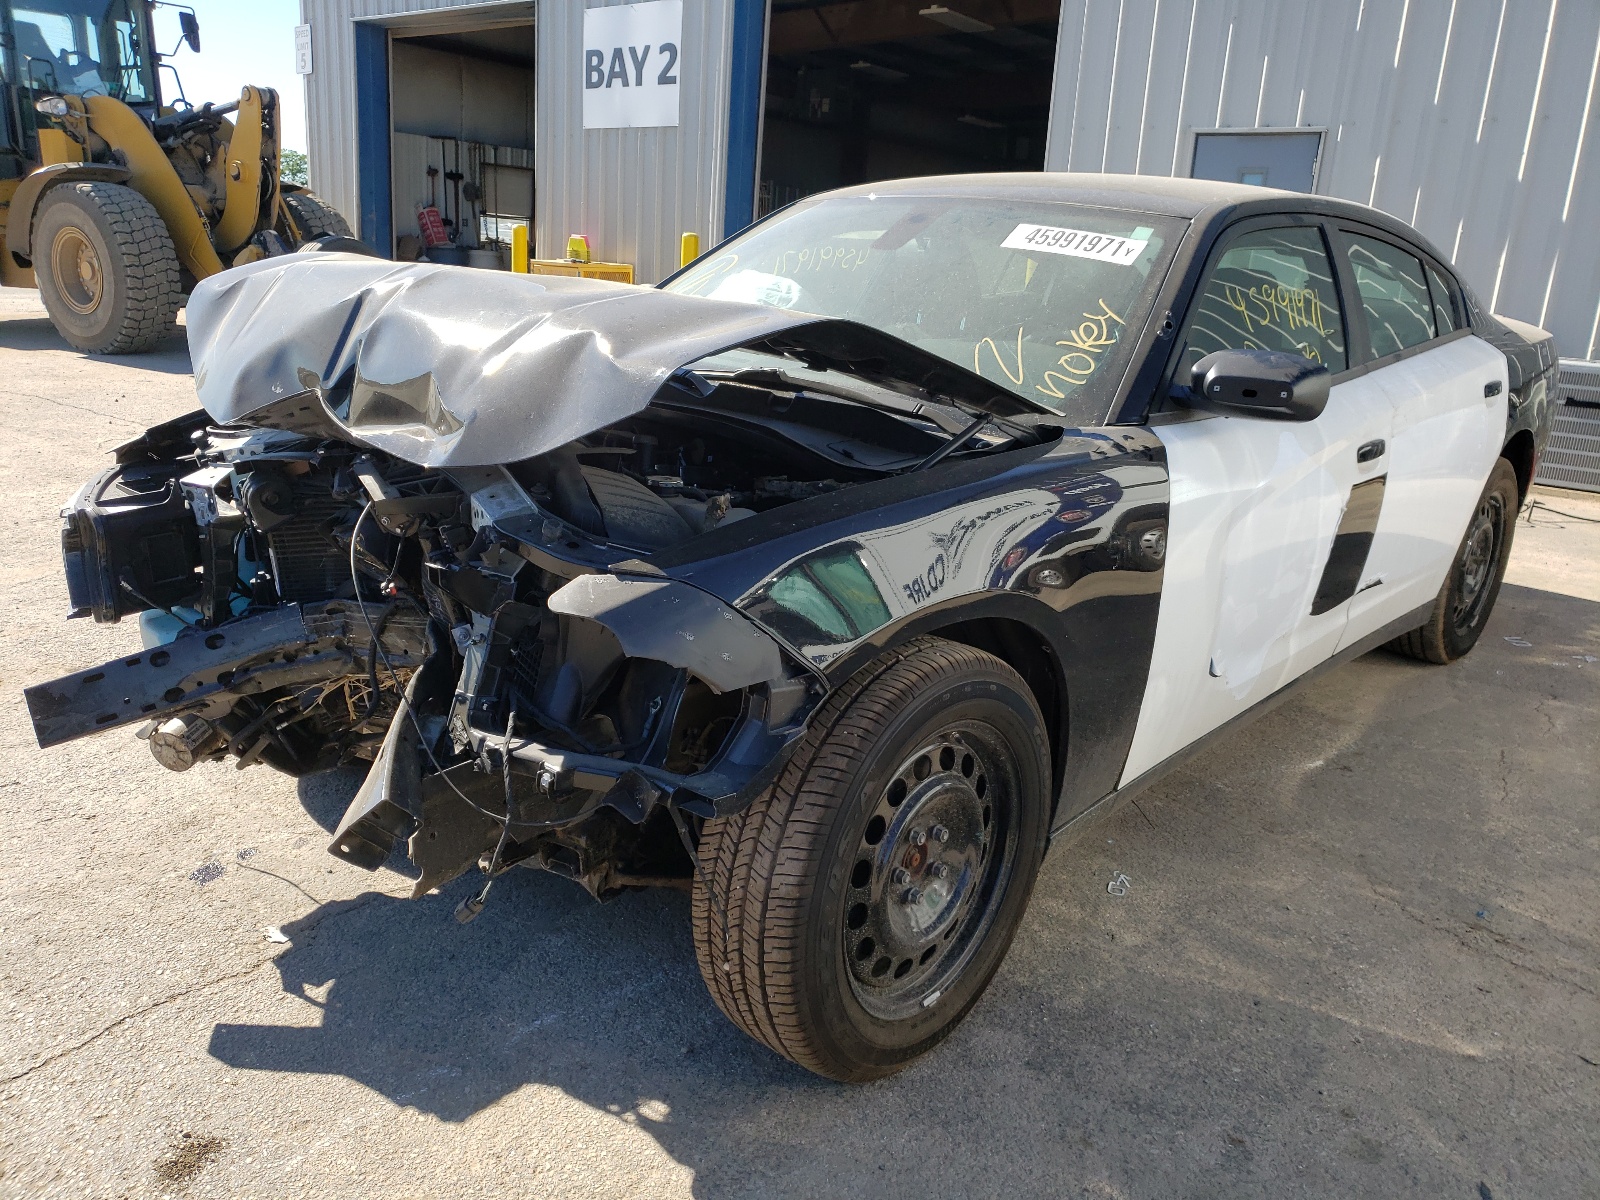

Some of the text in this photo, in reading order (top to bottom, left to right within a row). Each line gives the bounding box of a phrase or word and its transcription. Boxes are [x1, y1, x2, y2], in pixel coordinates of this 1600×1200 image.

[300, 52, 307, 70] 5
[585, 42, 678, 90] BAY 2
[1024, 227, 1126, 257] 45991971
